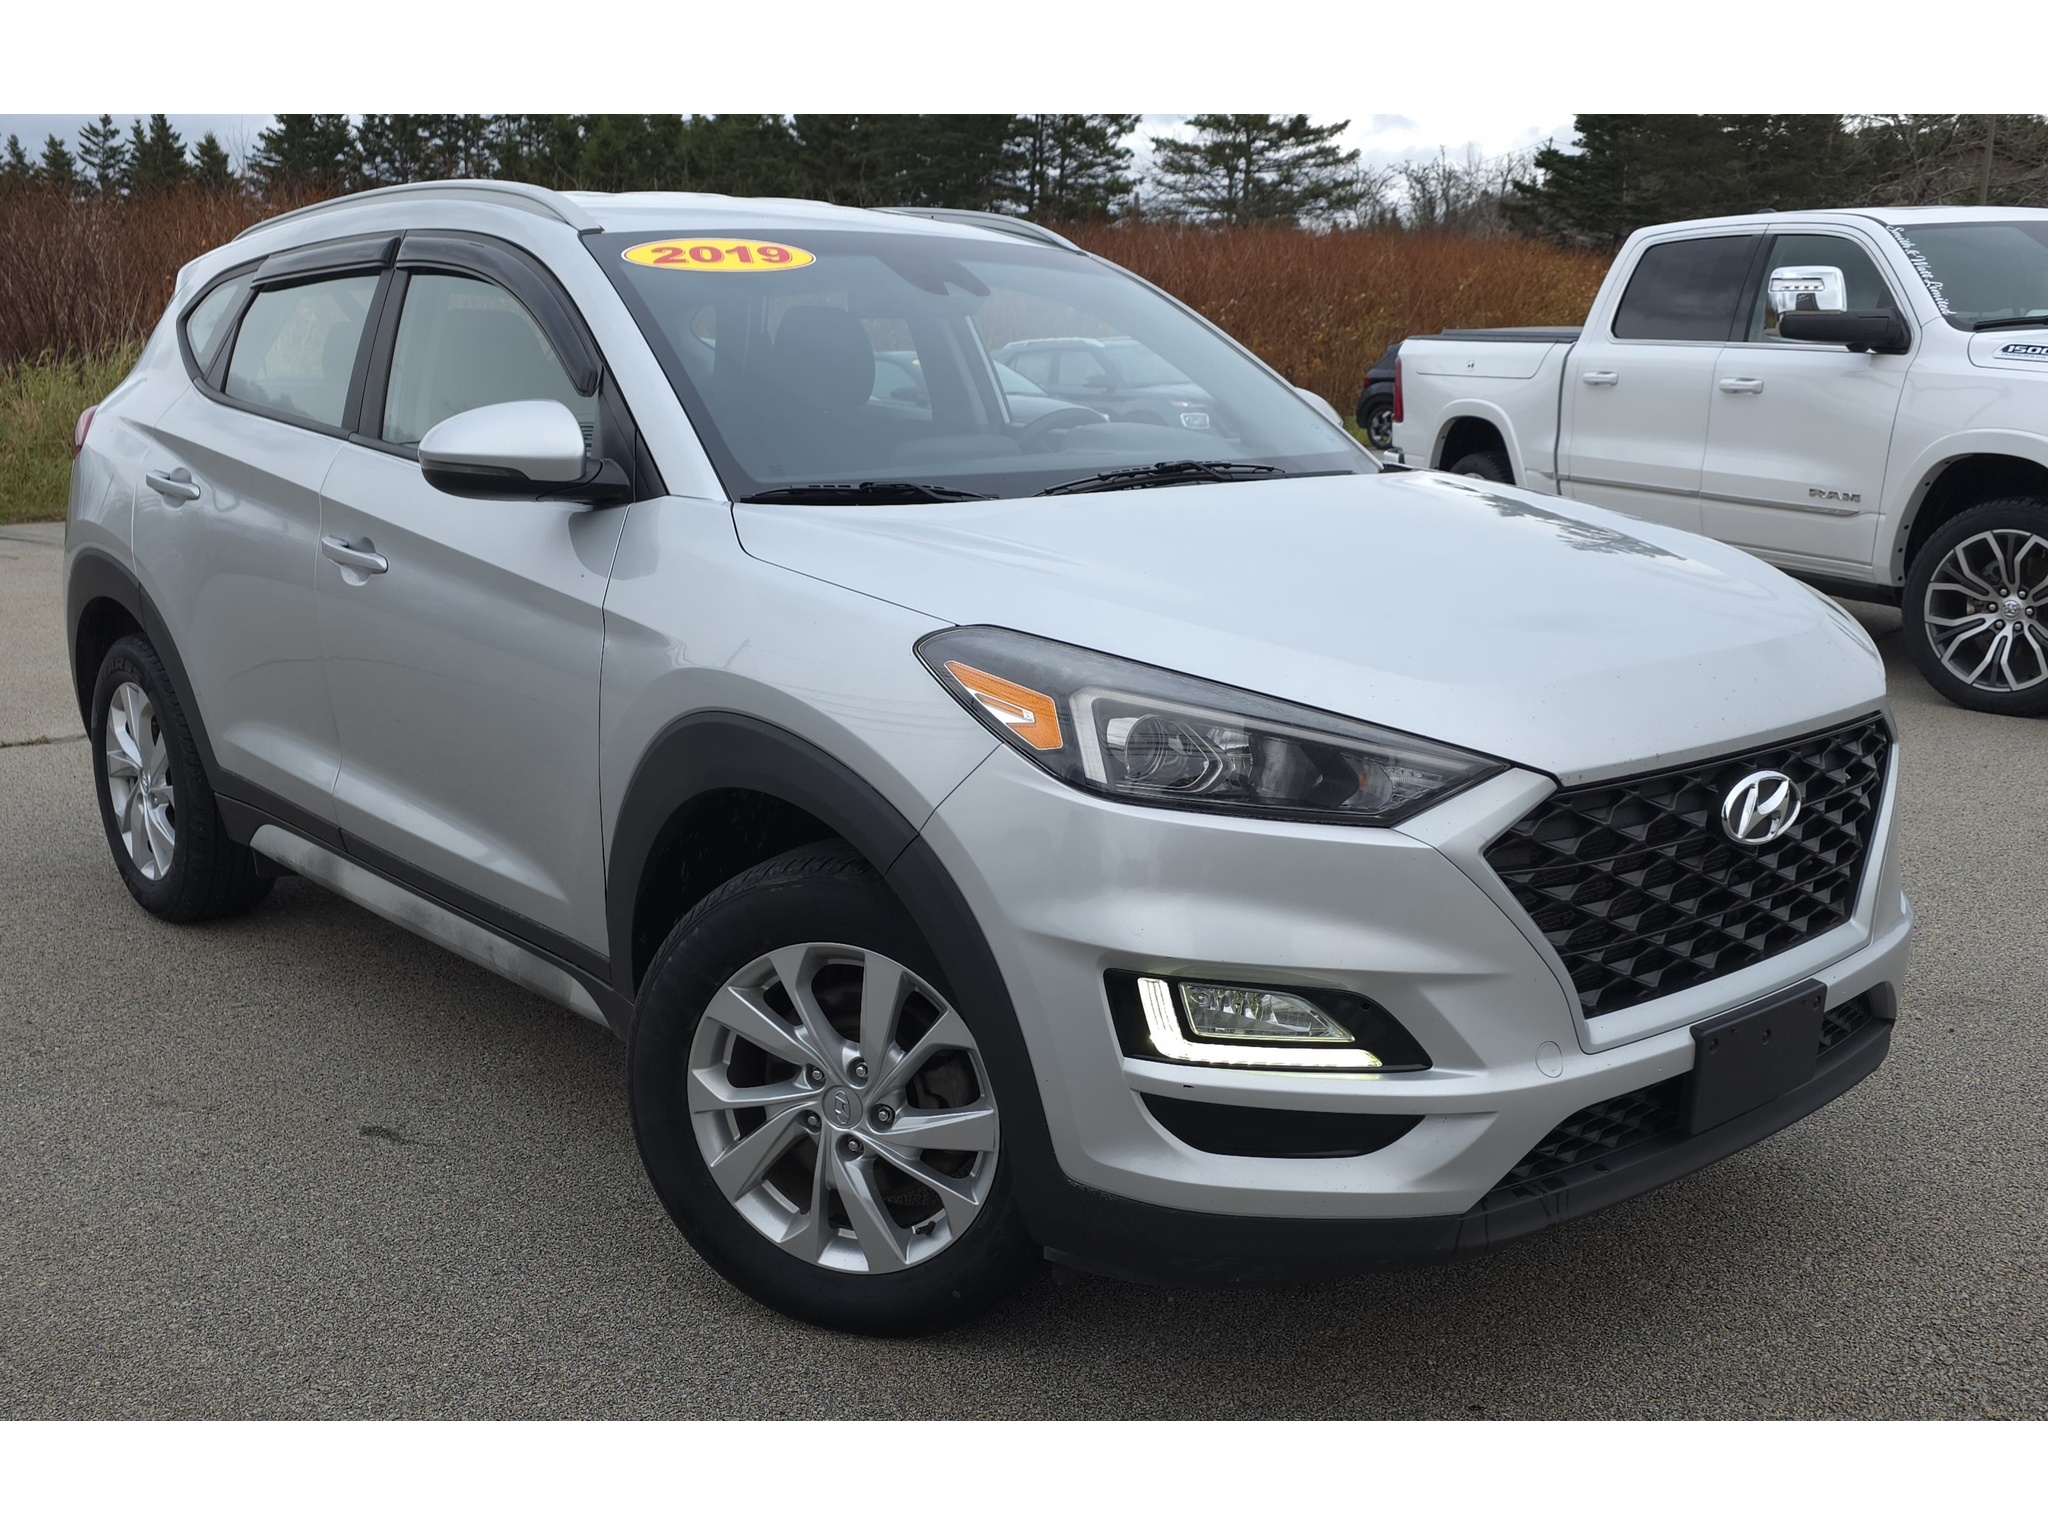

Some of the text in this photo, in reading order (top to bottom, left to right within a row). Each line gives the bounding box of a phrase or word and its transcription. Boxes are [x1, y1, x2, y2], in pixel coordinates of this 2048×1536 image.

[651, 246, 793, 264] 2019
[1886, 226, 1915, 248] Smith
[1910, 255, 1934, 278] Watt
[1924, 279, 1957, 315] Limited
[1809, 488, 1861, 503] RAM
